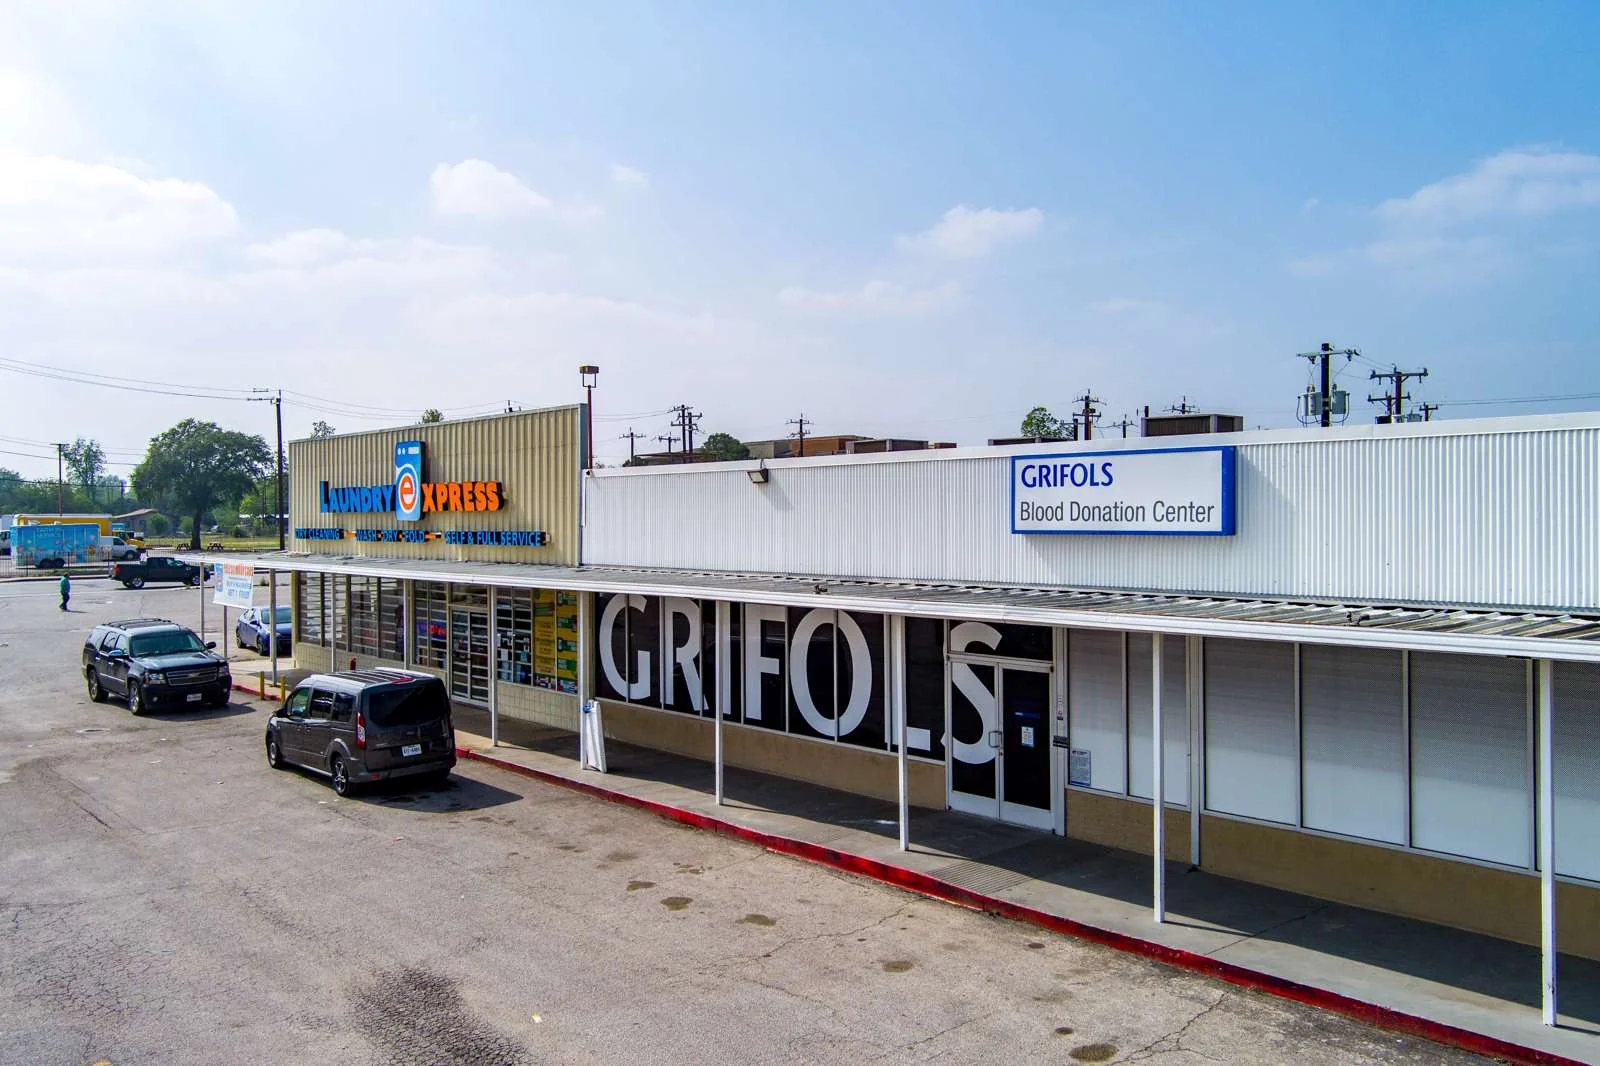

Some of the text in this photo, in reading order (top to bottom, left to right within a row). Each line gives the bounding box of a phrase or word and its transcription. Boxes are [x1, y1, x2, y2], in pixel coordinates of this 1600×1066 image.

[1020, 462, 1113, 488] GRIFOLS
[319, 480, 394, 513] LAUNDRY
[1020, 500, 1215, 522] Blood Donation Center
[308, 528, 340, 540] CLEANING
[356, 528, 377, 541] WASH
[382, 529, 398, 542] DRY
[403, 529, 424, 543] FOLD
[444, 531, 465, 544] SELF
[468, 531, 475, 544] &
[477, 531, 499, 545] FULL
[500, 531, 541, 547] SERVICE
[598, 593, 1003, 765] GRIFOLS
